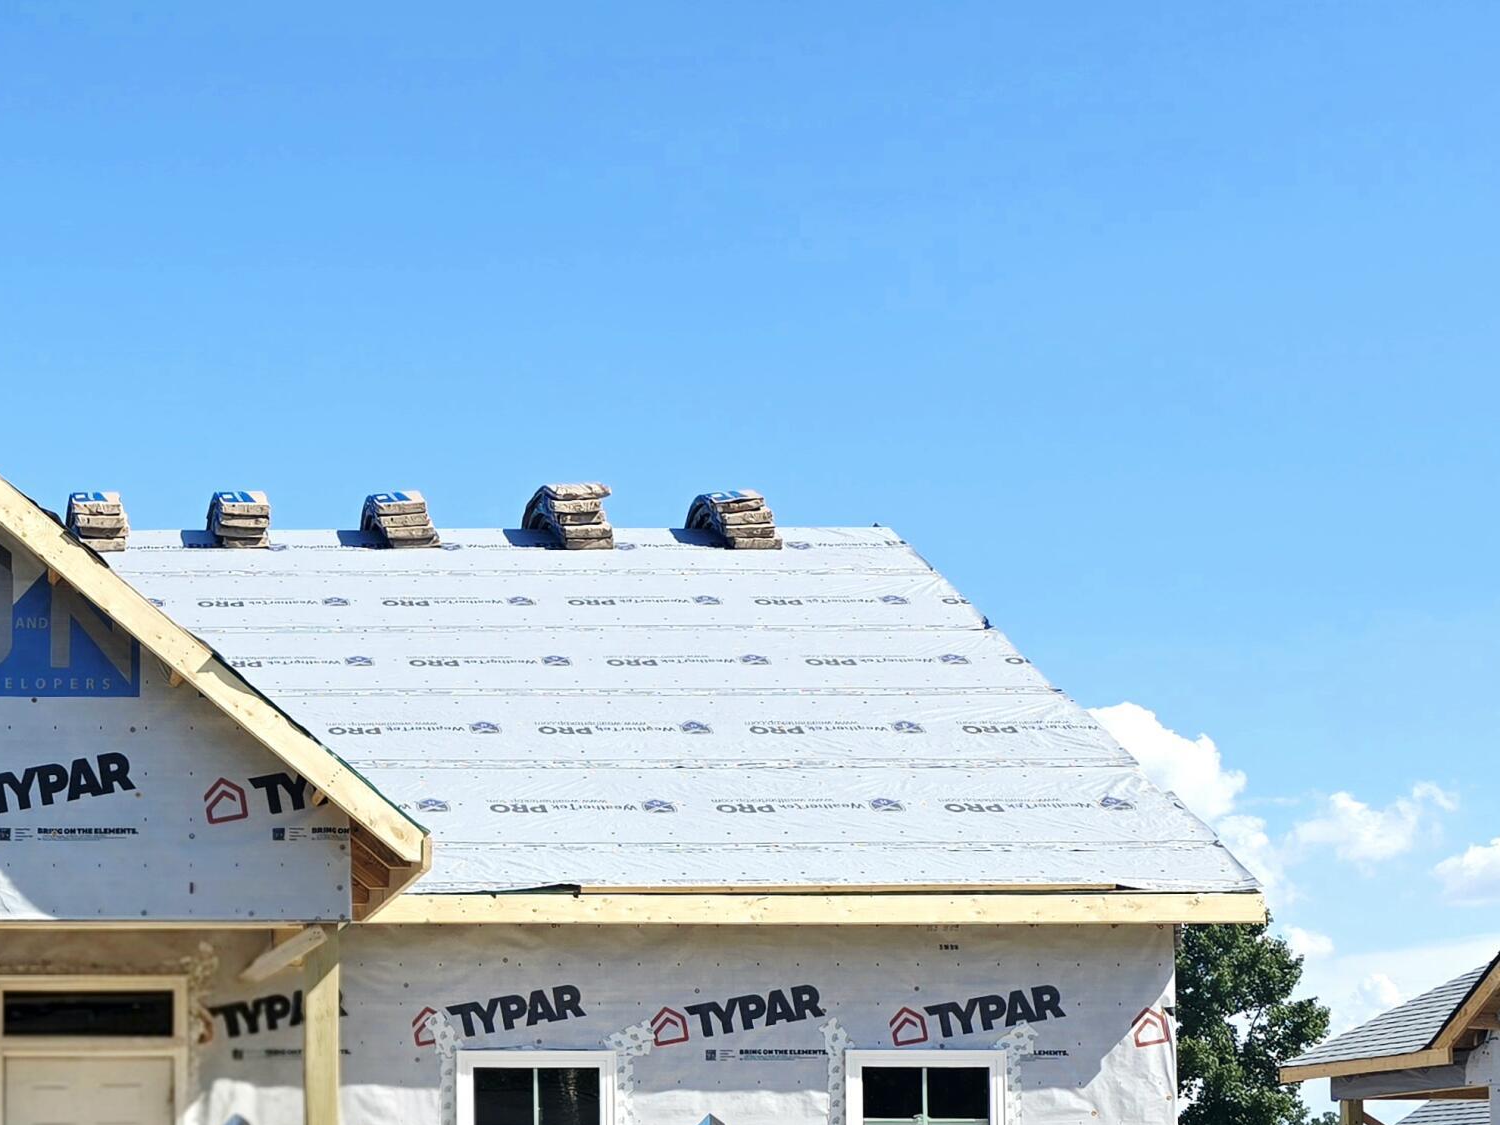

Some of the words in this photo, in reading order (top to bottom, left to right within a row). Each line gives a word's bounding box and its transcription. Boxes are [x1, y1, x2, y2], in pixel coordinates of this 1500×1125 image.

[15, 616, 49, 629] AND
[328, 727, 382, 735] PRO
[538, 726, 592, 735] PRO
[749, 726, 804, 734] PRO
[962, 726, 1018, 734] PRO
[490, 804, 548, 813] PRO
[716, 804, 775, 813] PRO
[944, 803, 1004, 812] PRO
[445, 984, 587, 1037] TYPAR
[684, 984, 825, 1037] TYPAR
[924, 984, 1066, 1038] TYPAR
